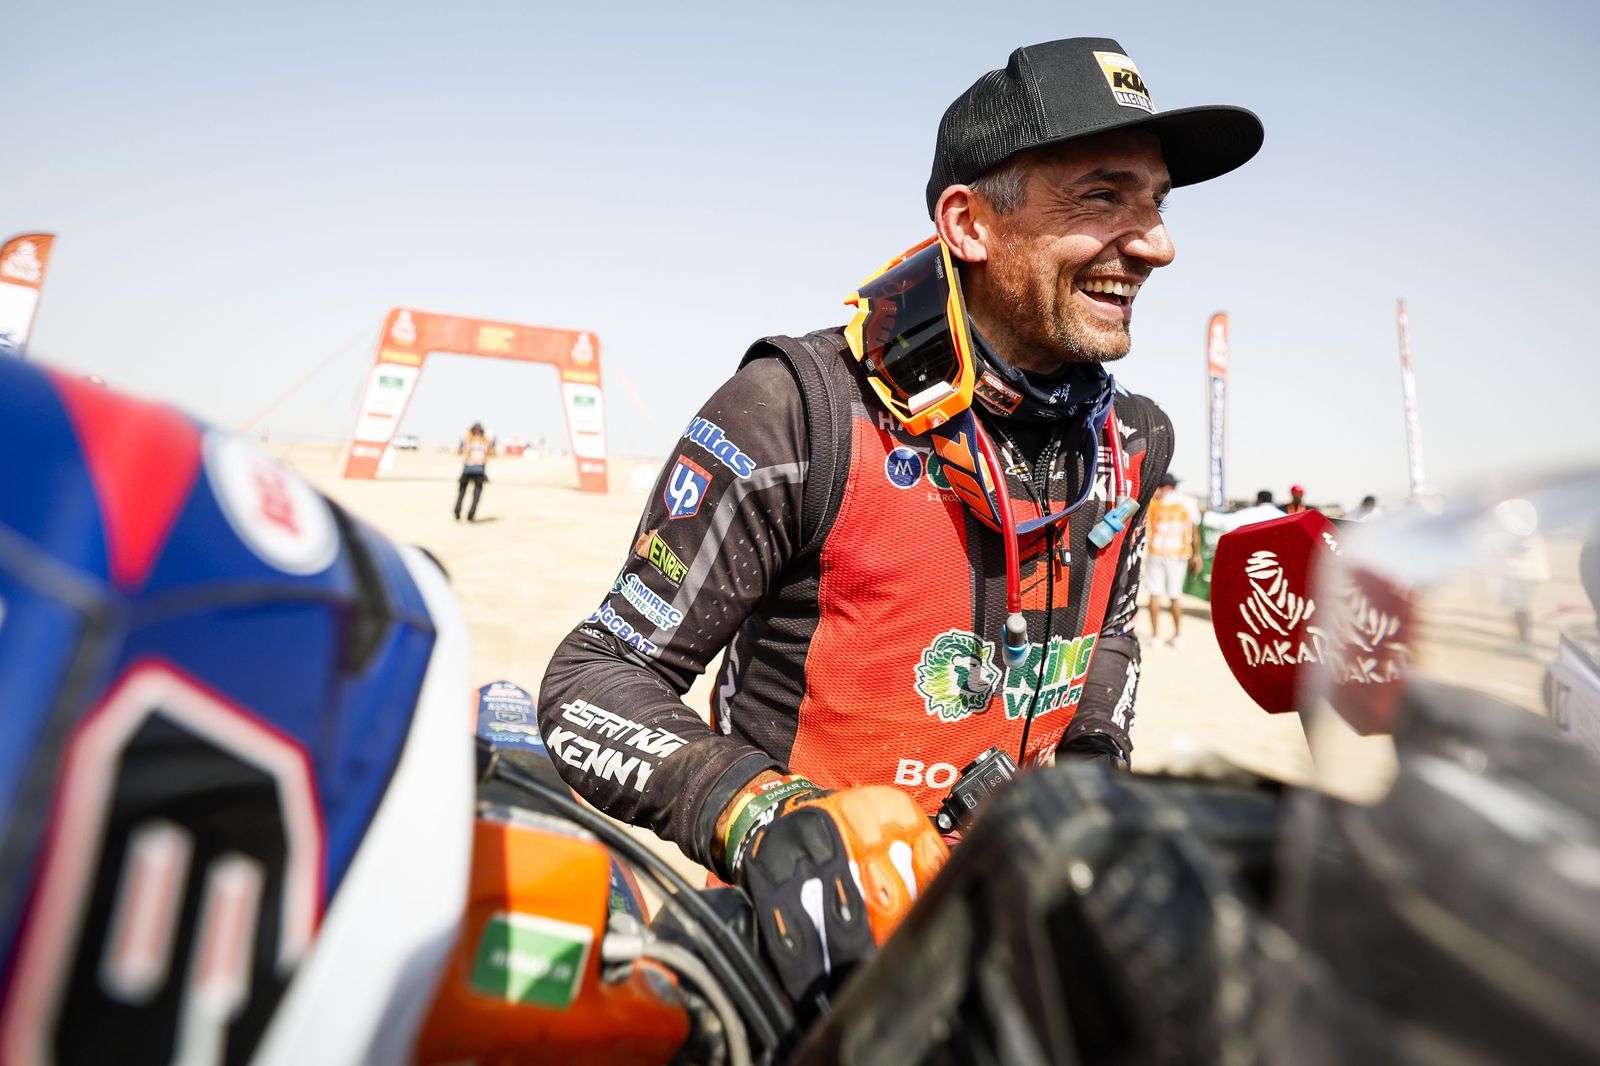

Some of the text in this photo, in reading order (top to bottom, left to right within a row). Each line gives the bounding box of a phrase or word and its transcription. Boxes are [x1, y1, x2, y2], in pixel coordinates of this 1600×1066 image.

[683, 416, 757, 479] Mitas
[648, 535, 688, 584] ENRIET
[626, 573, 682, 625] CHIMIREC
[546, 725, 654, 793] KENNY
[766, 783, 801, 801] DAKAR
